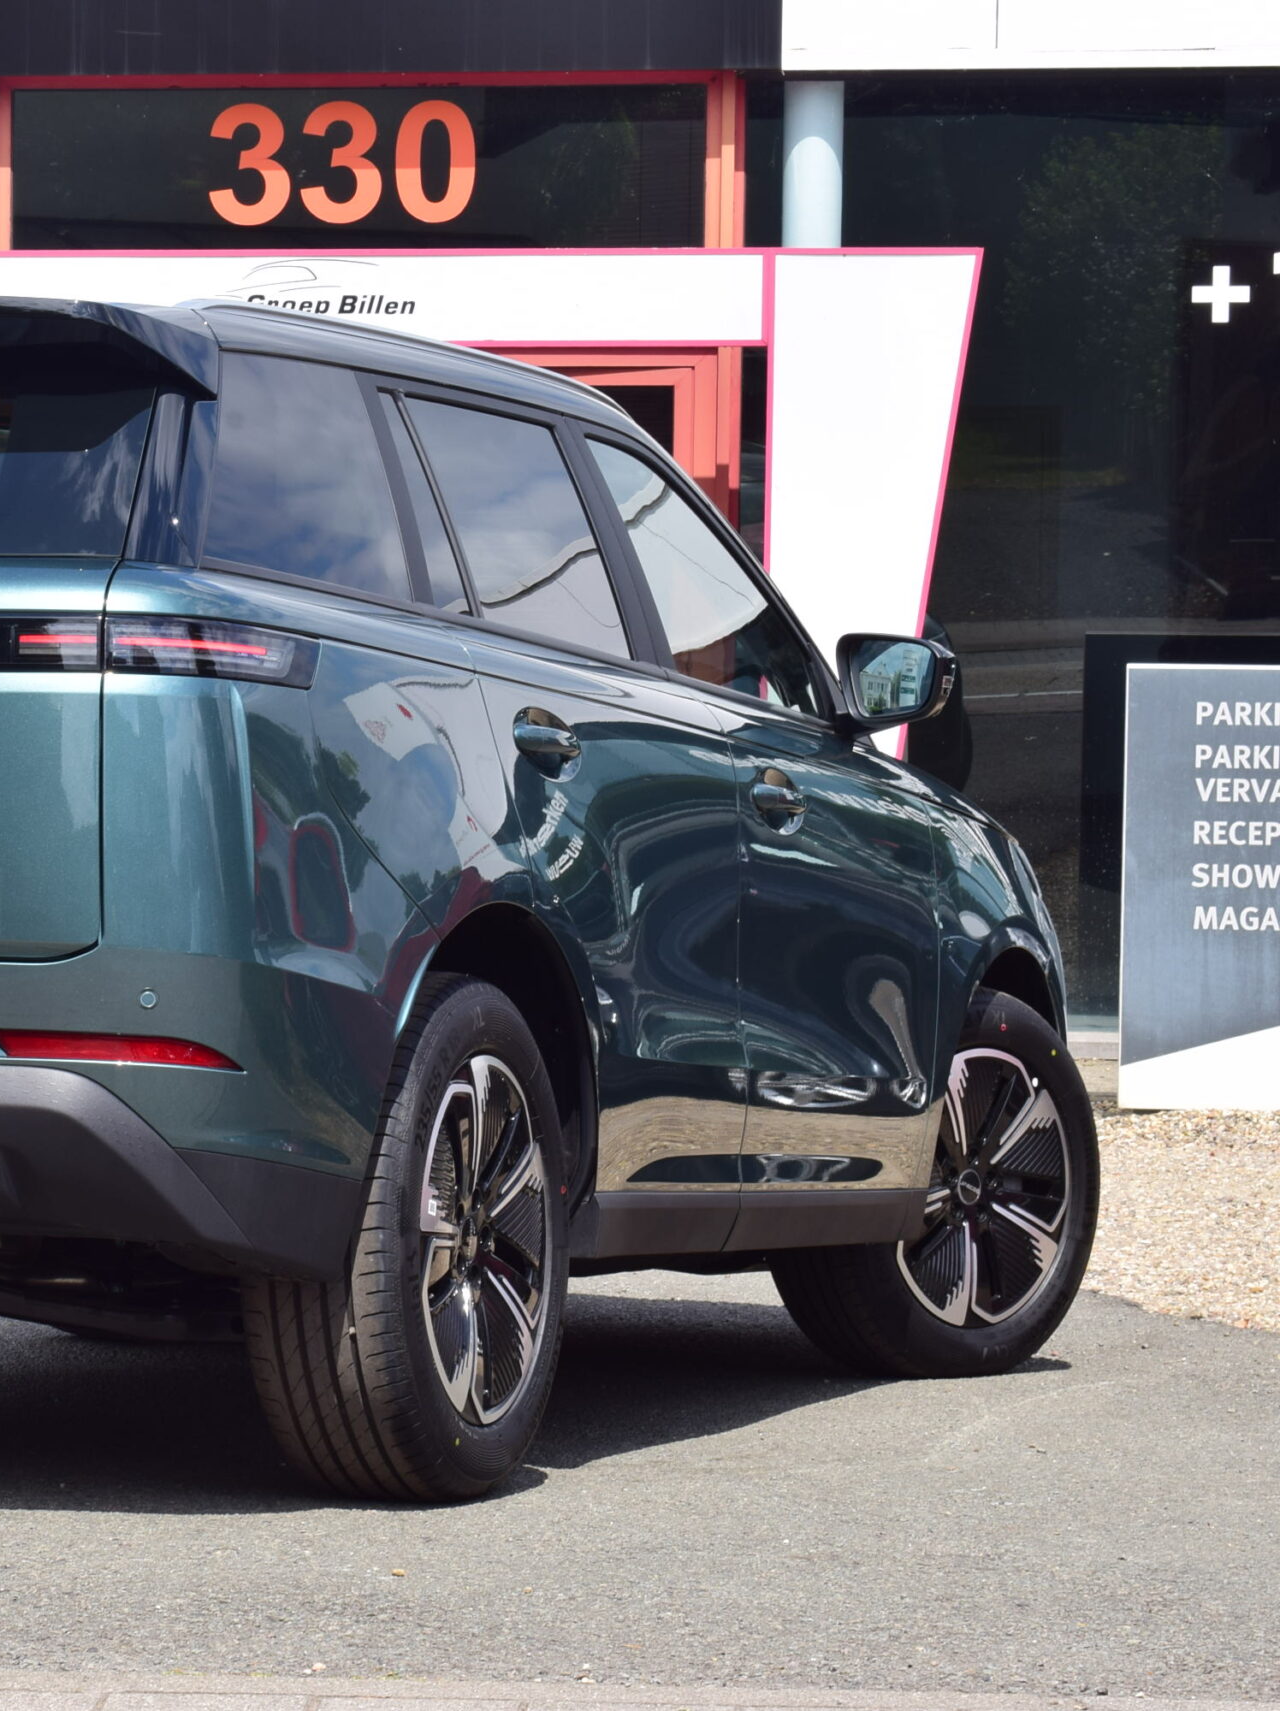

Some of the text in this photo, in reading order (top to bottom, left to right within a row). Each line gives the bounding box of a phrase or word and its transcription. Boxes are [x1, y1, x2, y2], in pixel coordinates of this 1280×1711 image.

[208, 99, 477, 227] 330
[338, 294, 416, 315] Billen
[1195, 701, 1280, 727] PARKI
[1194, 744, 1280, 770] PARKI
[1193, 820, 1280, 846] RECEP
[1191, 862, 1280, 889] SHOW
[1193, 905, 1280, 932] MAGA
